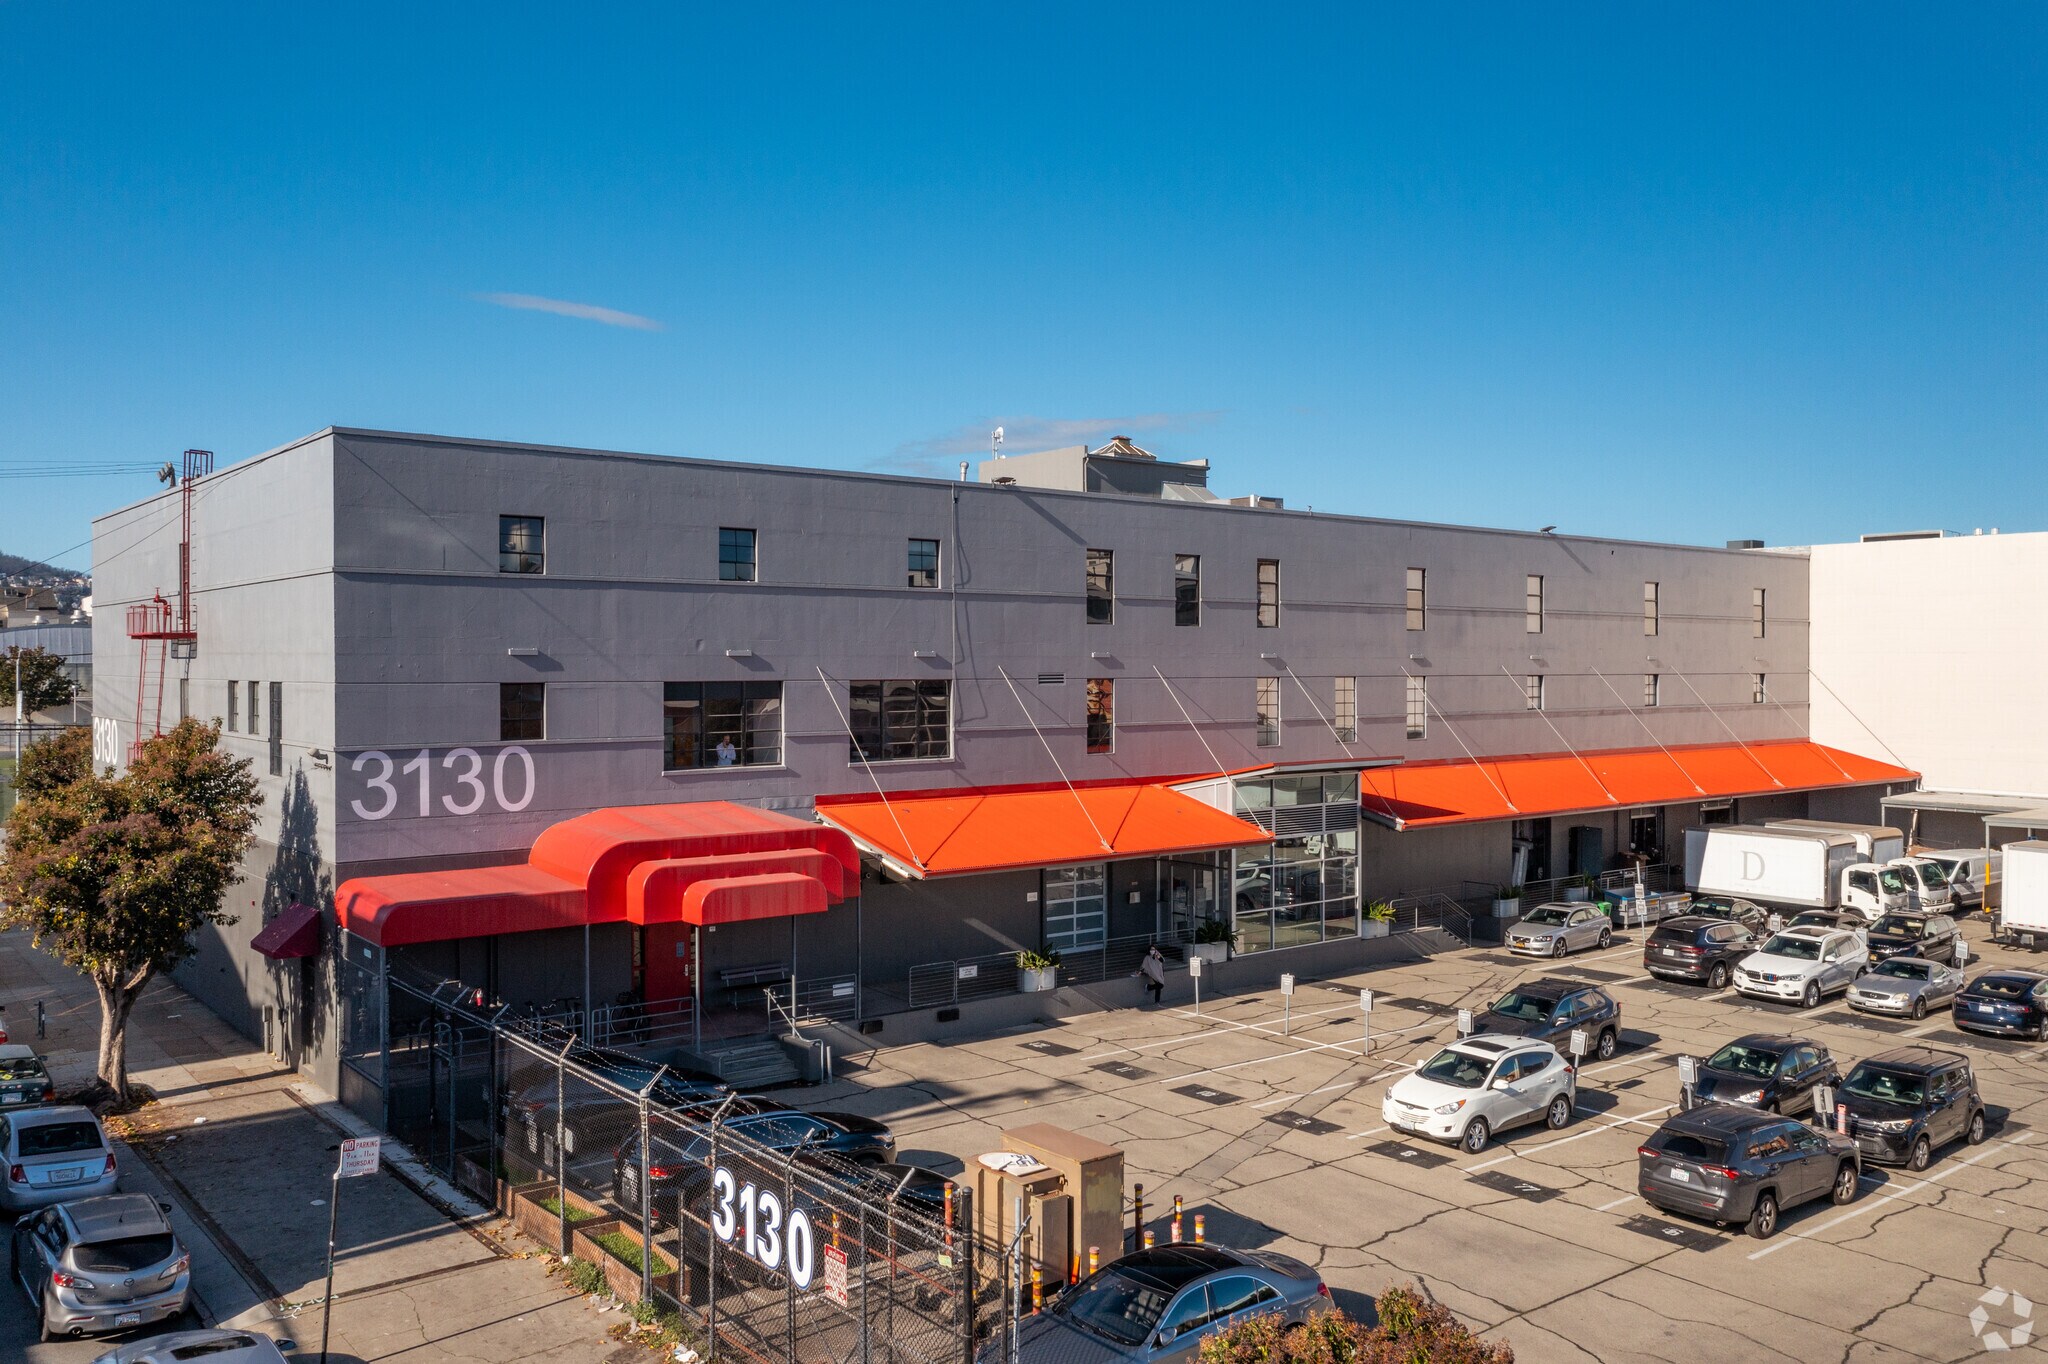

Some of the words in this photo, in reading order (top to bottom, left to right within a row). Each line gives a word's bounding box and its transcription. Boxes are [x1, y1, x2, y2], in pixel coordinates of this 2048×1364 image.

[94, 716, 118, 765] 3130
[350, 745, 536, 821] 3130
[1740, 850, 1766, 881] D
[343, 1140, 354, 1151] NO
[356, 1140, 378, 1149] PARKING
[346, 1159, 375, 1168] THURSDAY
[711, 1166, 814, 1291] 3130
